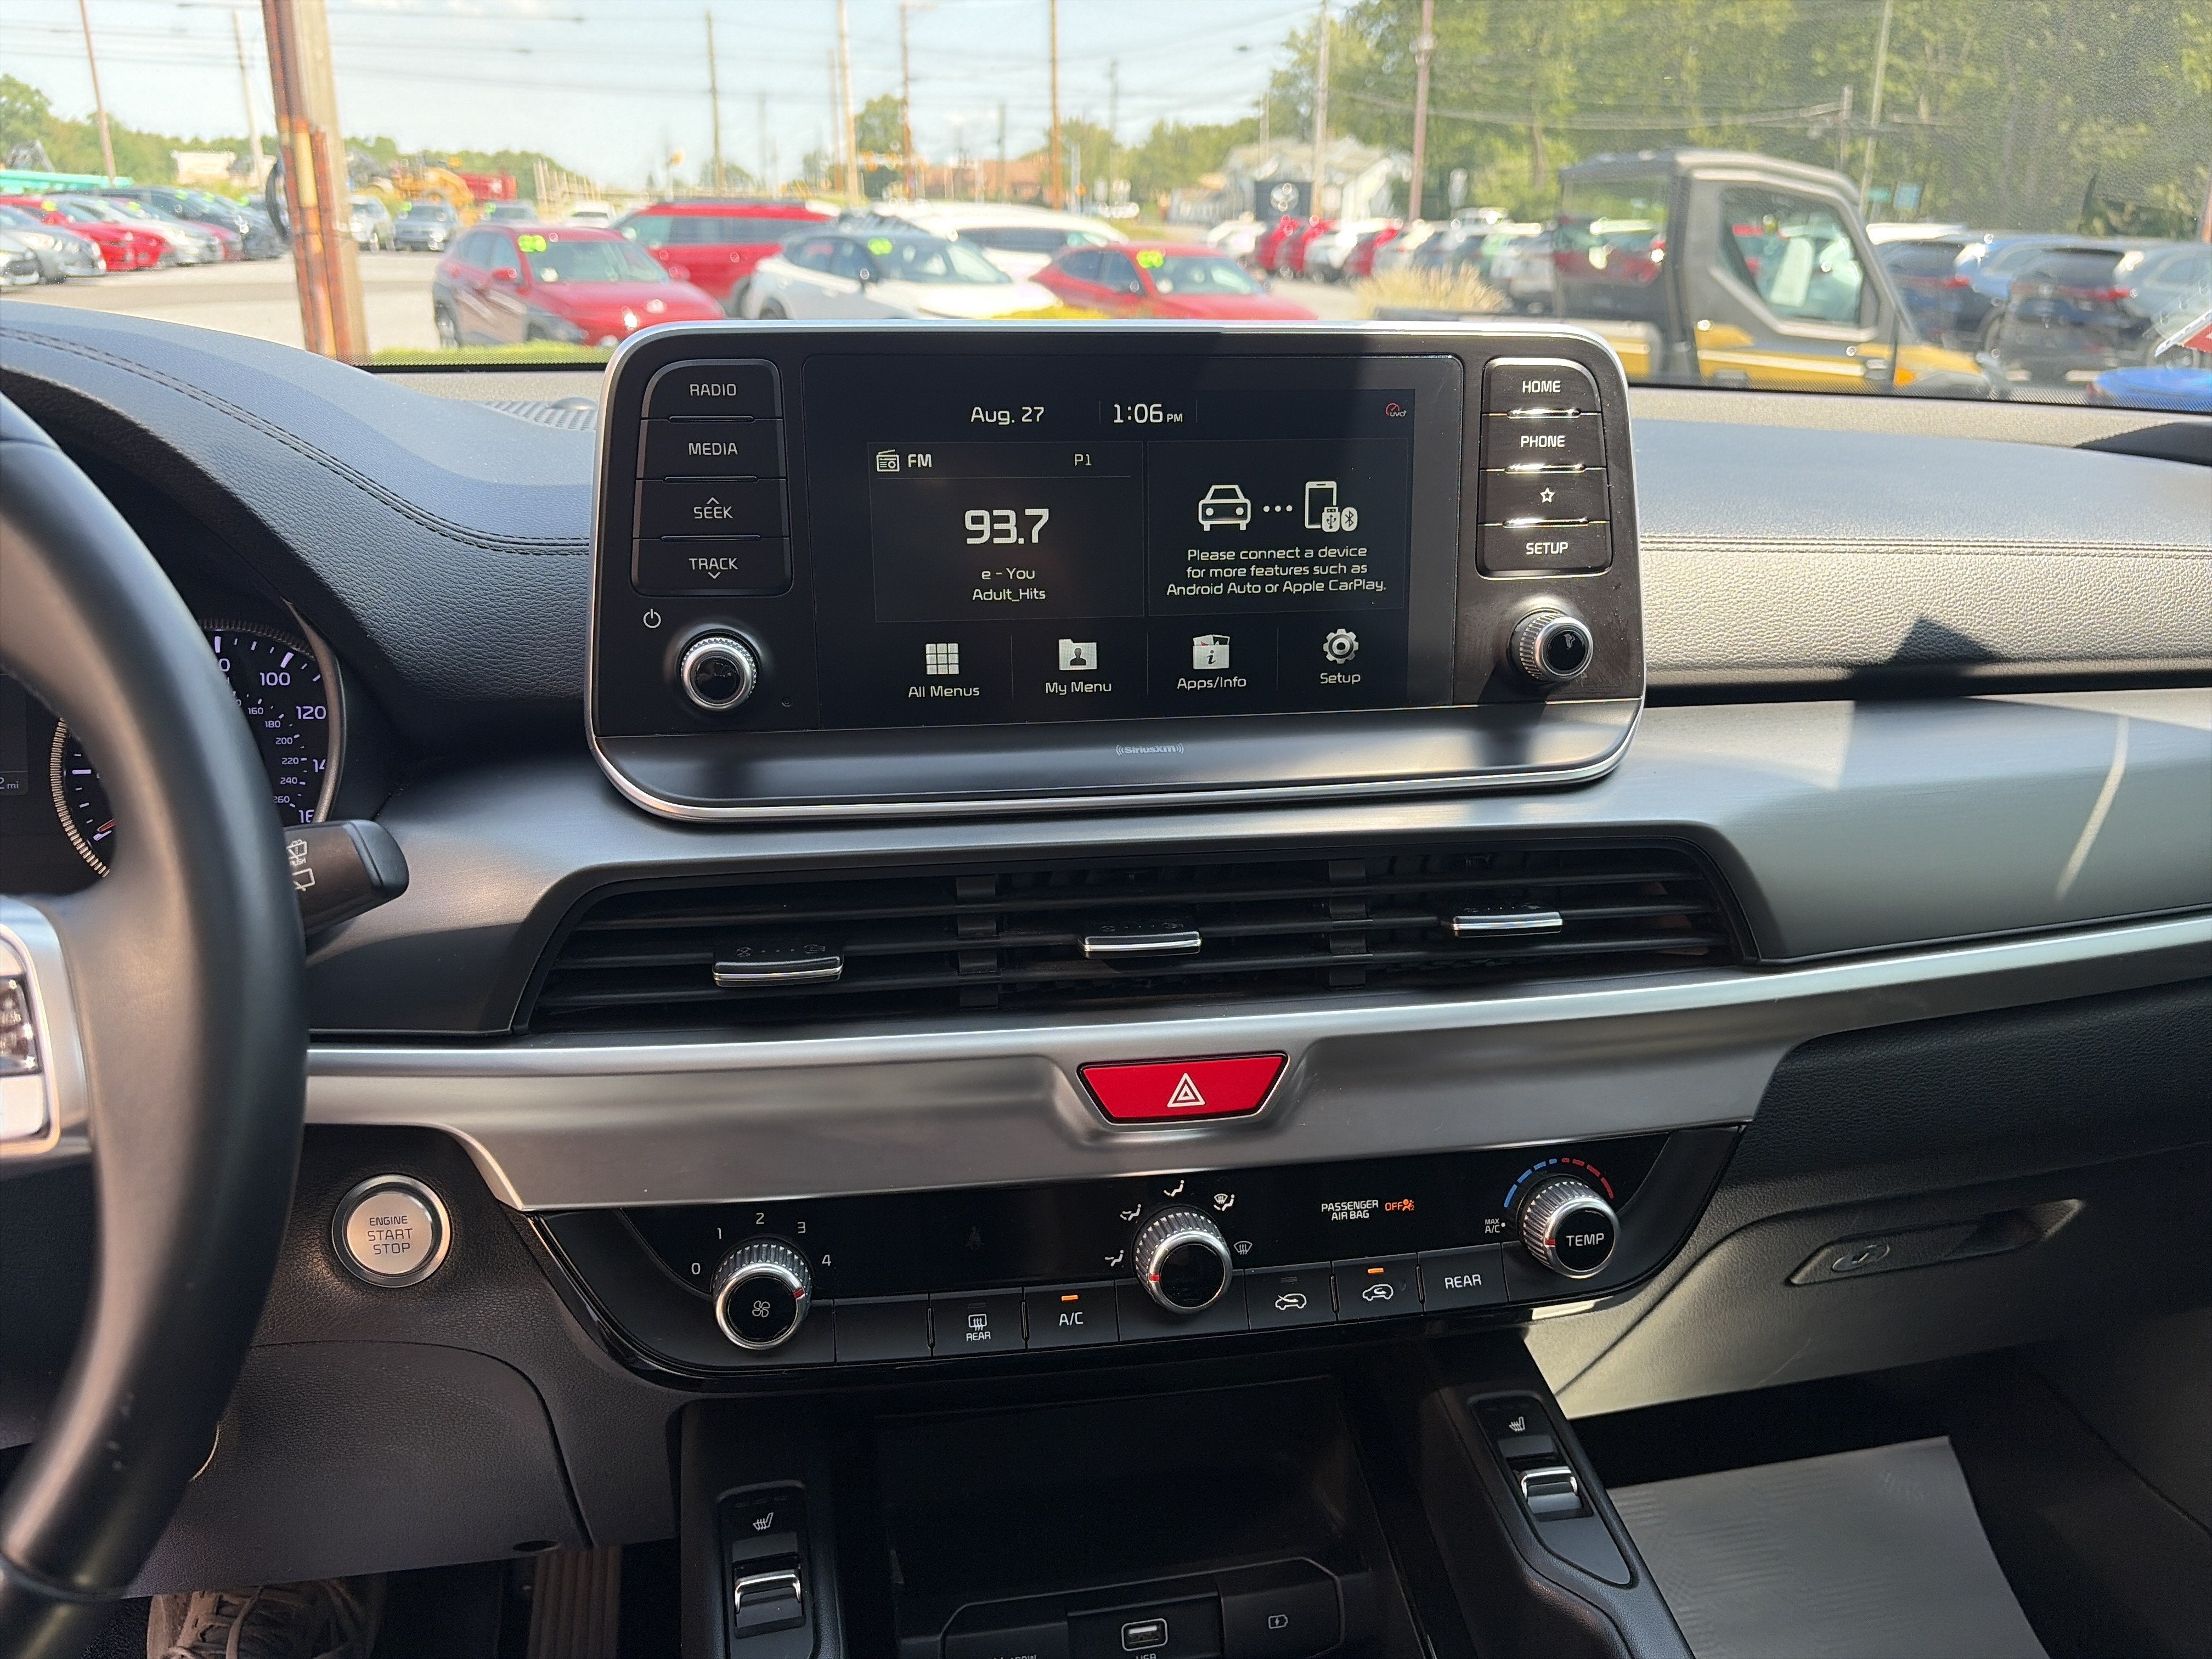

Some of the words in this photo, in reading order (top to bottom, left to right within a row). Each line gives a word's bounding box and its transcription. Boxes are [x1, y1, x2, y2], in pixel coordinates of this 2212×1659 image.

[690, 383, 736, 396] RADIO
[1522, 380, 1561, 393] HOME
[970, 407, 1015, 425] Aug.
[1022, 407, 1045, 422] 27
[1113, 403, 1163, 424] 1:06
[1166, 414, 1183, 422] PM
[1520, 435, 1565, 448] PHONE
[689, 442, 738, 455] MEDIA
[907, 454, 932, 468] FM
[1074, 454, 1092, 466] P1
[693, 506, 733, 519] SEEK
[964, 508, 1049, 544] 93.7
[1188, 549, 1235, 561] Please
[1240, 546, 1301, 560] connect
[1304, 549, 1314, 558] a
[1318, 545, 1367, 558] device
[1526, 541, 1568, 555] SETUP
[688, 557, 738, 571] TRACK
[1186, 566, 1206, 578] for
[1210, 568, 1246, 578] more
[1250, 564, 1310, 577] features
[1313, 562, 1347, 575] such
[1351, 565, 1368, 574] as
[981, 571, 991, 580] e
[1006, 567, 1035, 579] You
[1166, 583, 1223, 596] Android
[1227, 582, 1261, 594] Auto
[1265, 584, 1279, 593] or
[1282, 580, 1325, 594] Apple
[1329, 579, 1386, 592] CarPlay.
[972, 588, 1046, 602] Adult_Hits
[259, 672, 291, 686] 100
[1177, 676, 1246, 691] Apps/Info
[1320, 672, 1361, 685] Setup
[908, 686, 926, 698] All
[930, 685, 980, 697] Menus
[1046, 682, 1067, 696] My
[1071, 681, 1112, 693] Menu
[247, 707, 264, 715] 160
[296, 706, 326, 720] 120
[264, 720, 281, 728] 180
[275, 737, 293, 745] 200
[7, 781, 19, 789] mi
[1321, 1199, 1379, 1212] PASSENGER
[1385, 1201, 1403, 1211] OFF
[369, 1215, 408, 1226] ENGINE
[755, 1212, 765, 1224] 2
[1331, 1211, 1348, 1221] AIR
[1350, 1210, 1369, 1219] BAG
[717, 1227, 722, 1240] 1
[797, 1221, 806, 1234] 3
[1485, 1224, 1500, 1234] A/C
[368, 1228, 413, 1242] START
[1566, 1233, 1604, 1247] TEMP
[373, 1242, 410, 1255] STOP
[821, 1254, 832, 1266] 4
[691, 1262, 701, 1275] 0
[1444, 1274, 1482, 1289] REAR
[1059, 1312, 1084, 1327] A/C
[966, 1331, 991, 1341] REAR
